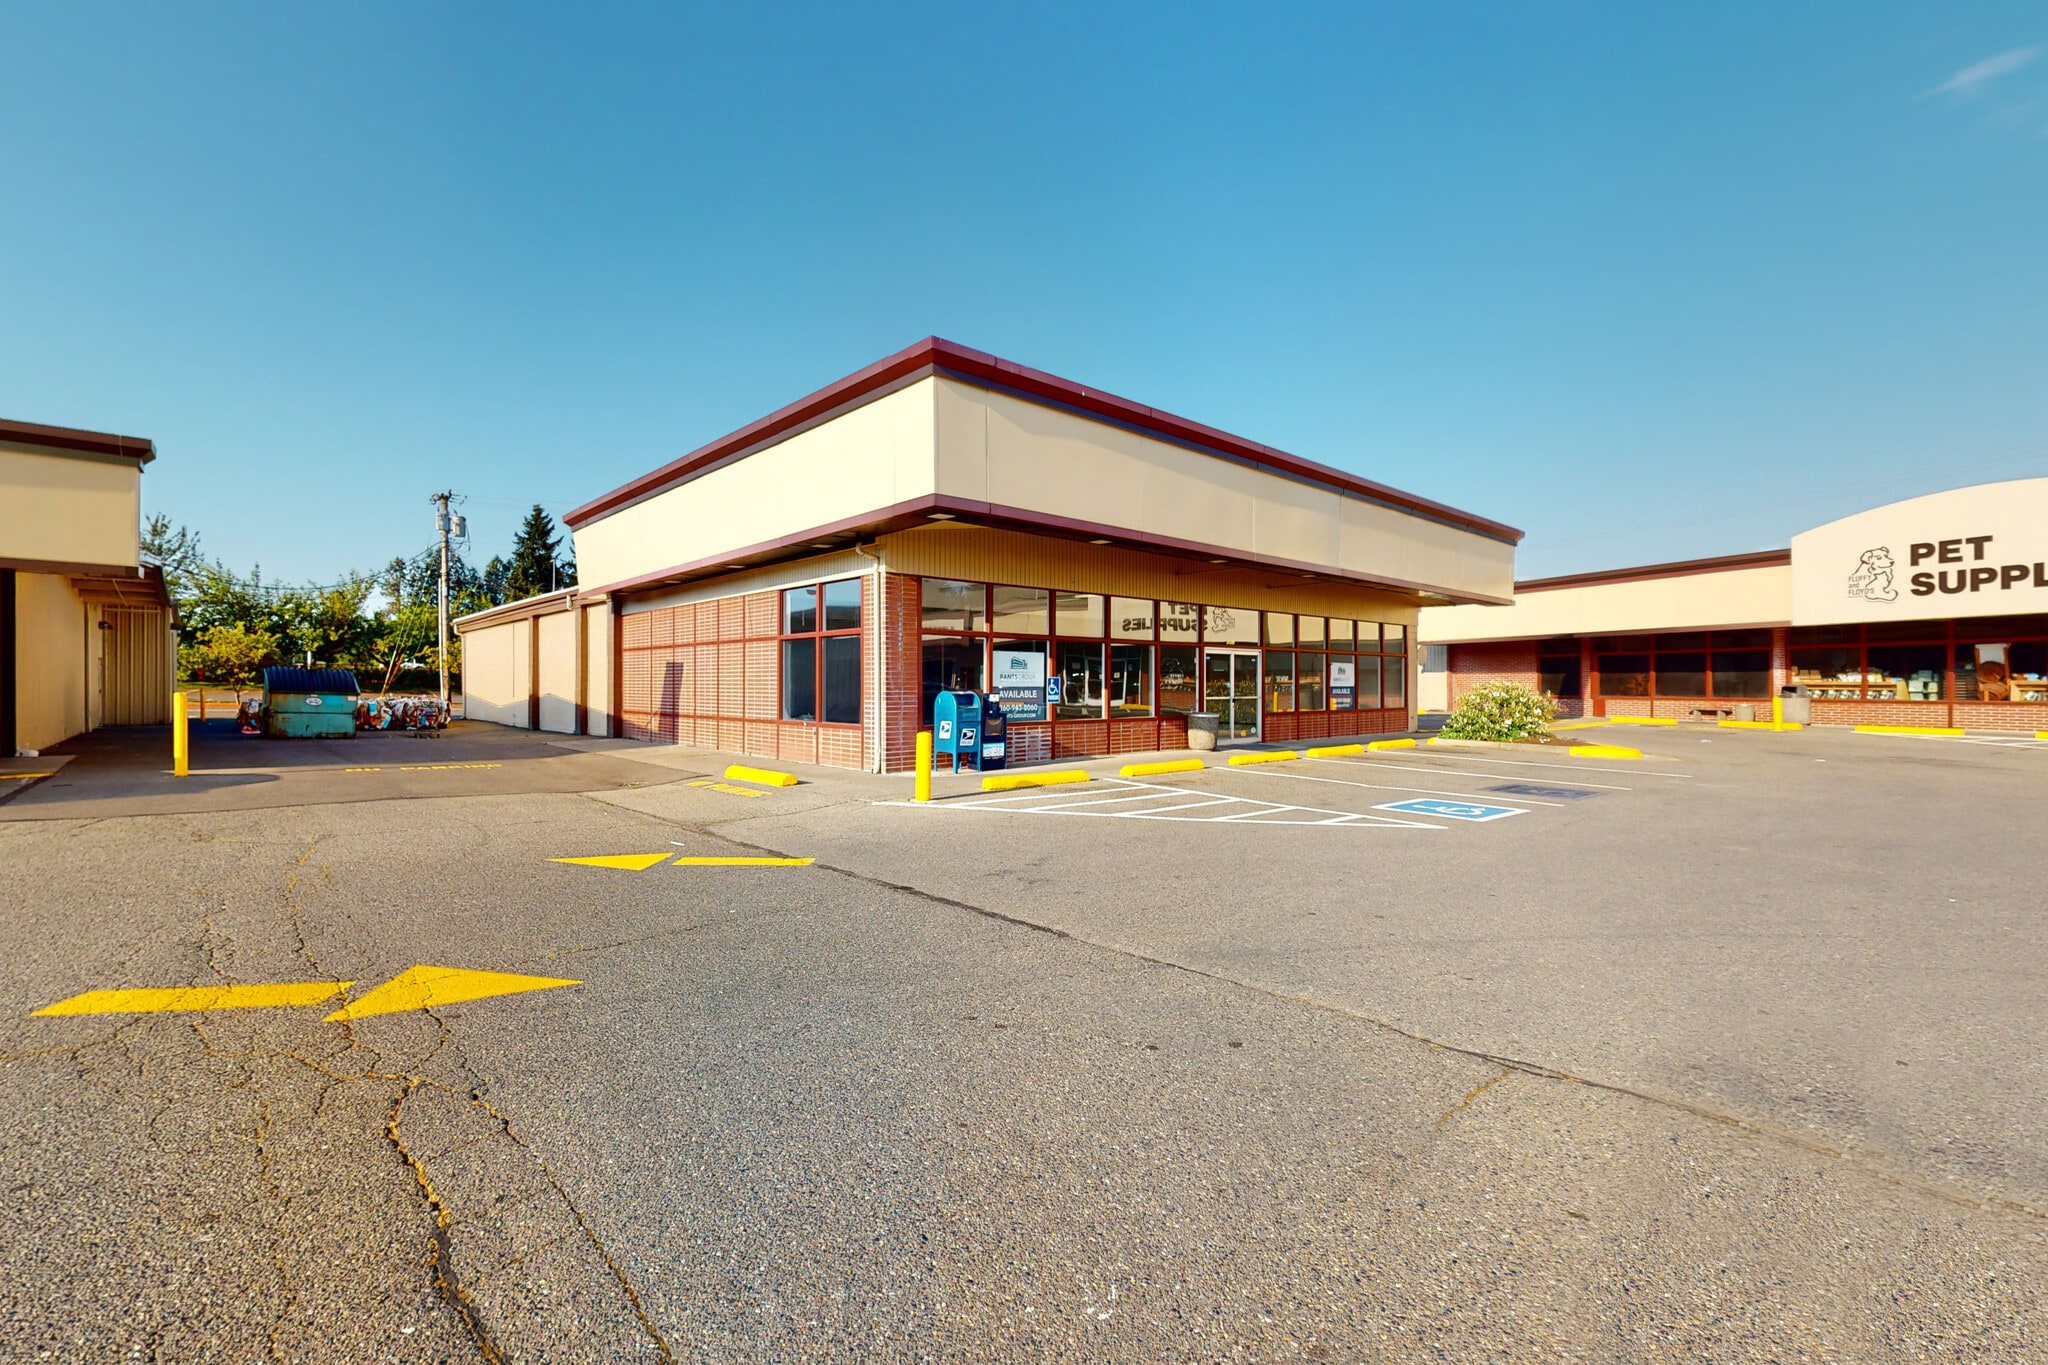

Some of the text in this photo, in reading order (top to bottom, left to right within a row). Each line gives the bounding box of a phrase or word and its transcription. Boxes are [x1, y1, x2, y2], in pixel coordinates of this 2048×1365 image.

[1910, 535, 1993, 567] PET
[1848, 575, 1871, 583] FLUFFY
[1910, 562, 2048, 597] SUPPL
[999, 690, 1037, 698] AVAILABLE
